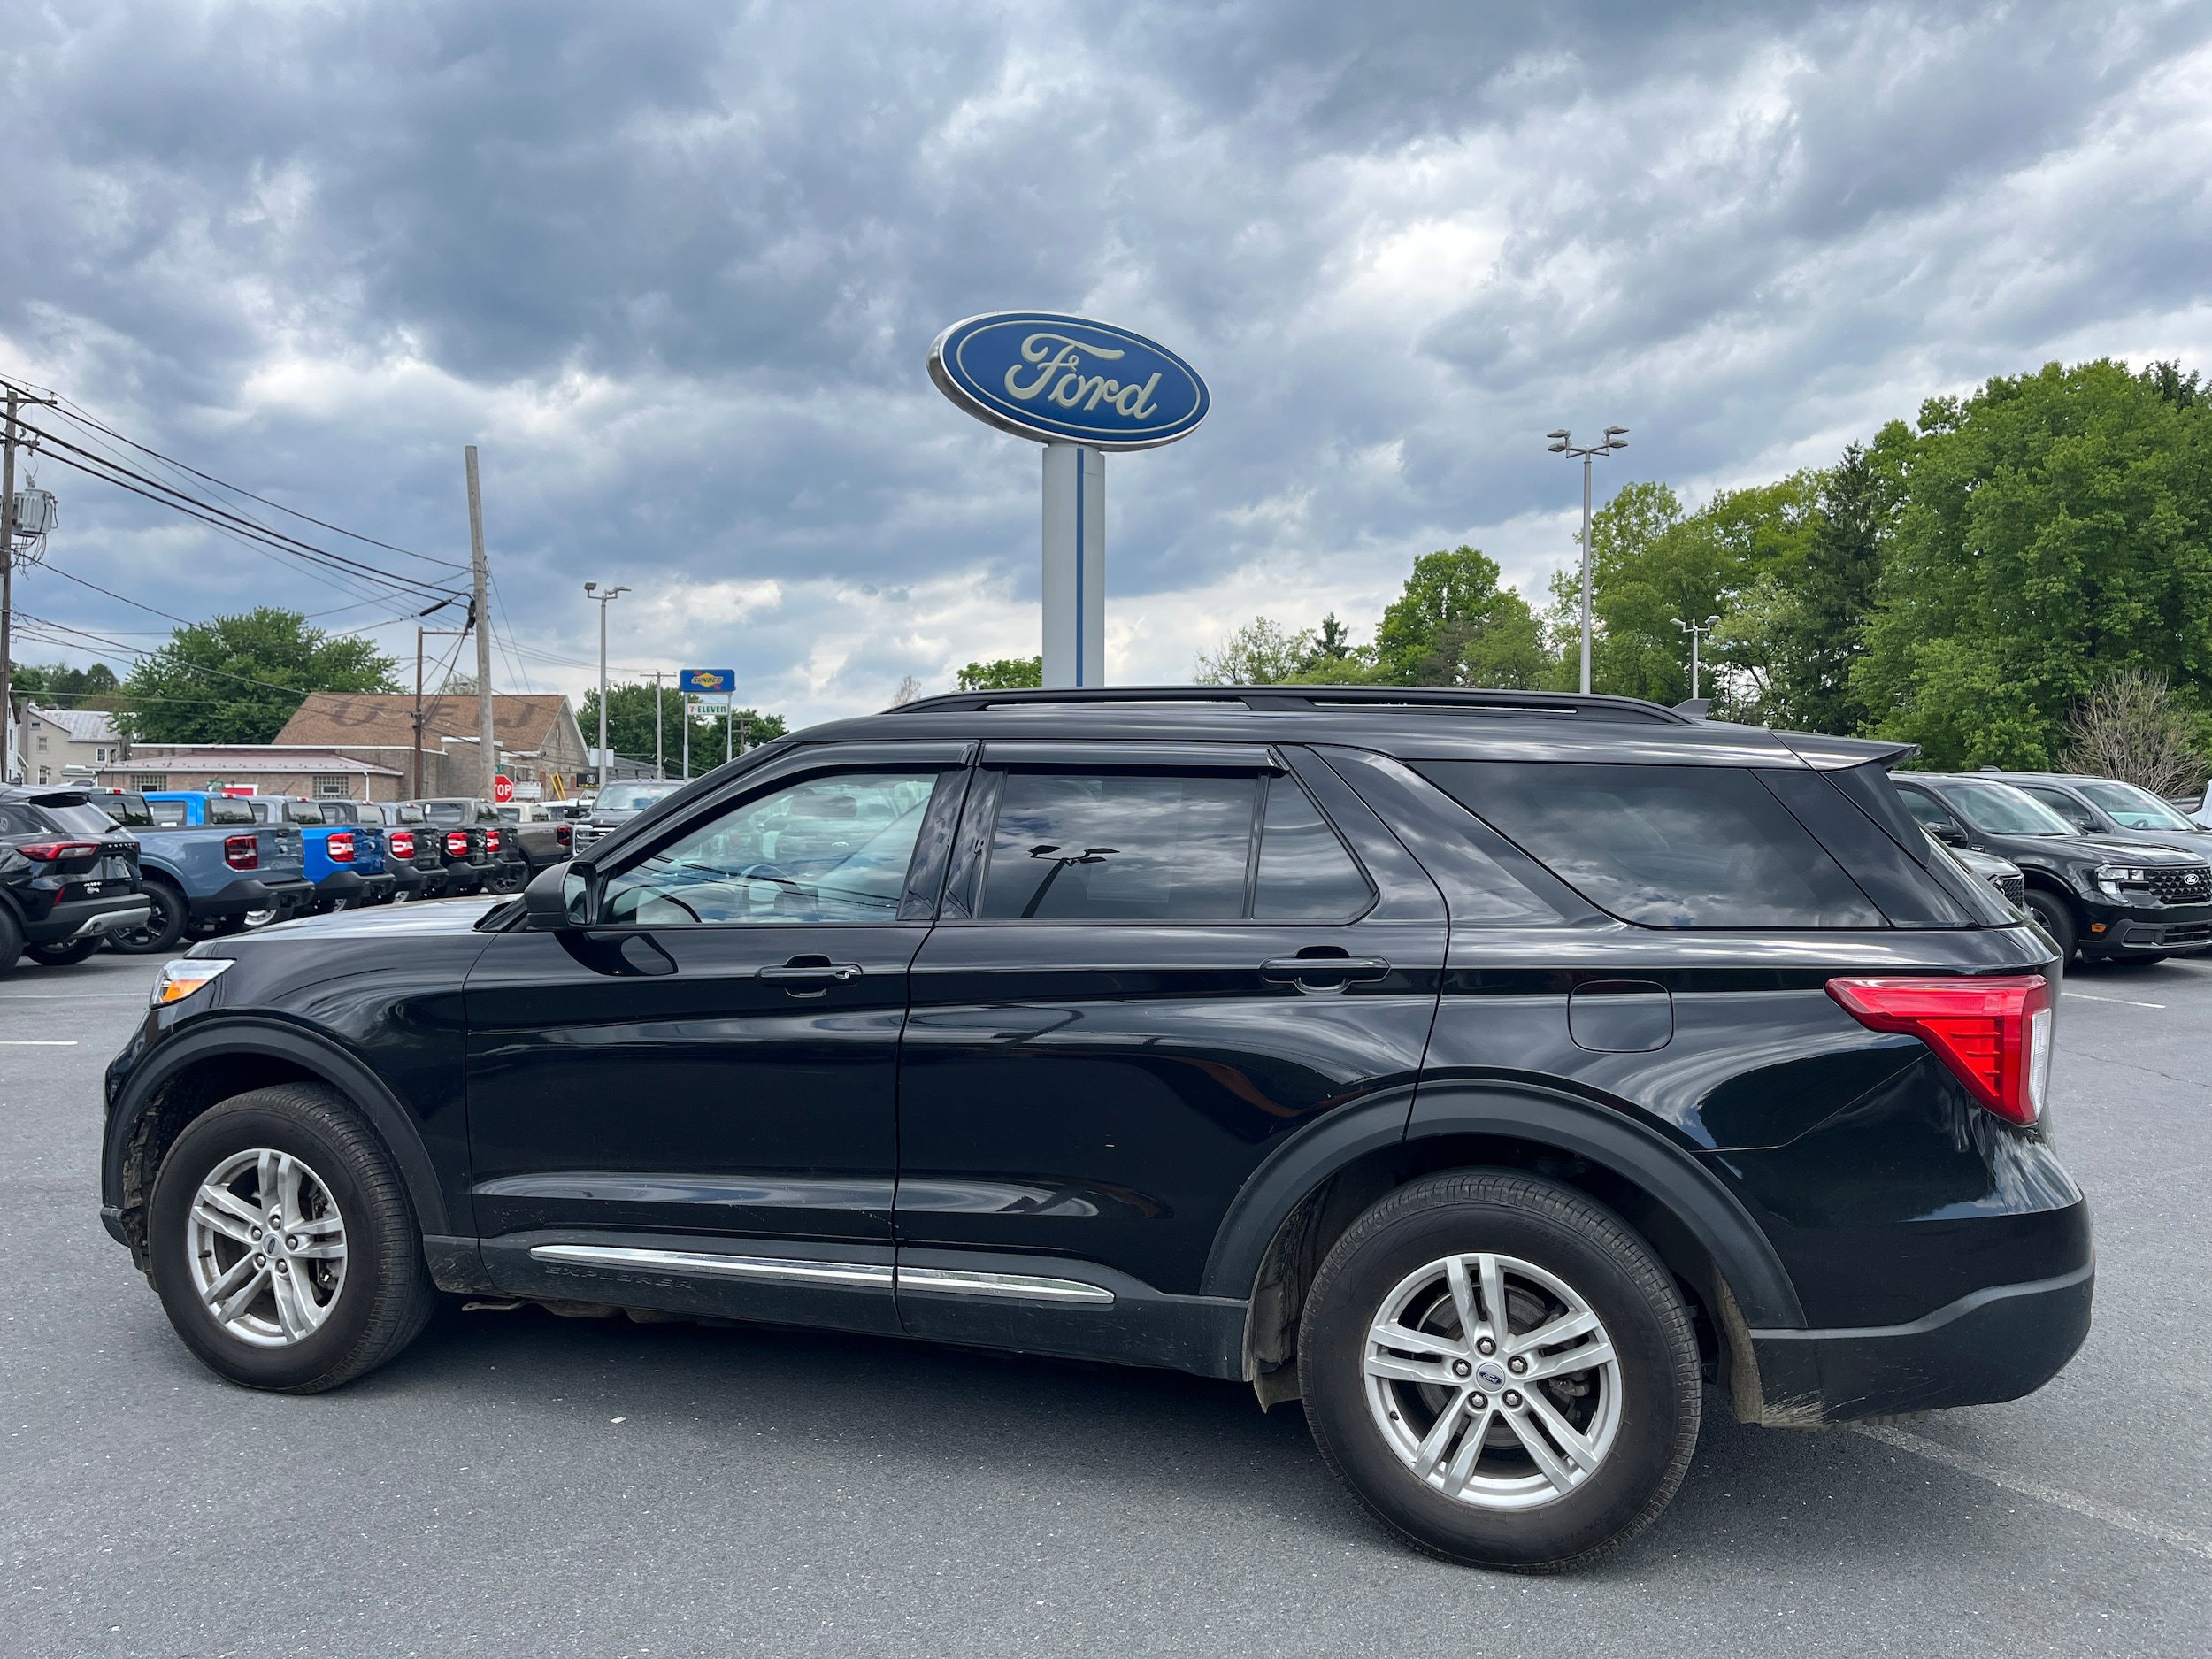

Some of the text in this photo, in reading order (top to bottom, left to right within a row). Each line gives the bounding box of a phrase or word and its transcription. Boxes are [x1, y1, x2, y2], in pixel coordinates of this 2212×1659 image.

[1004, 333, 1162, 419] Ford
[495, 784, 511, 796] OP
[545, 1265, 692, 1289] EXPLORER
